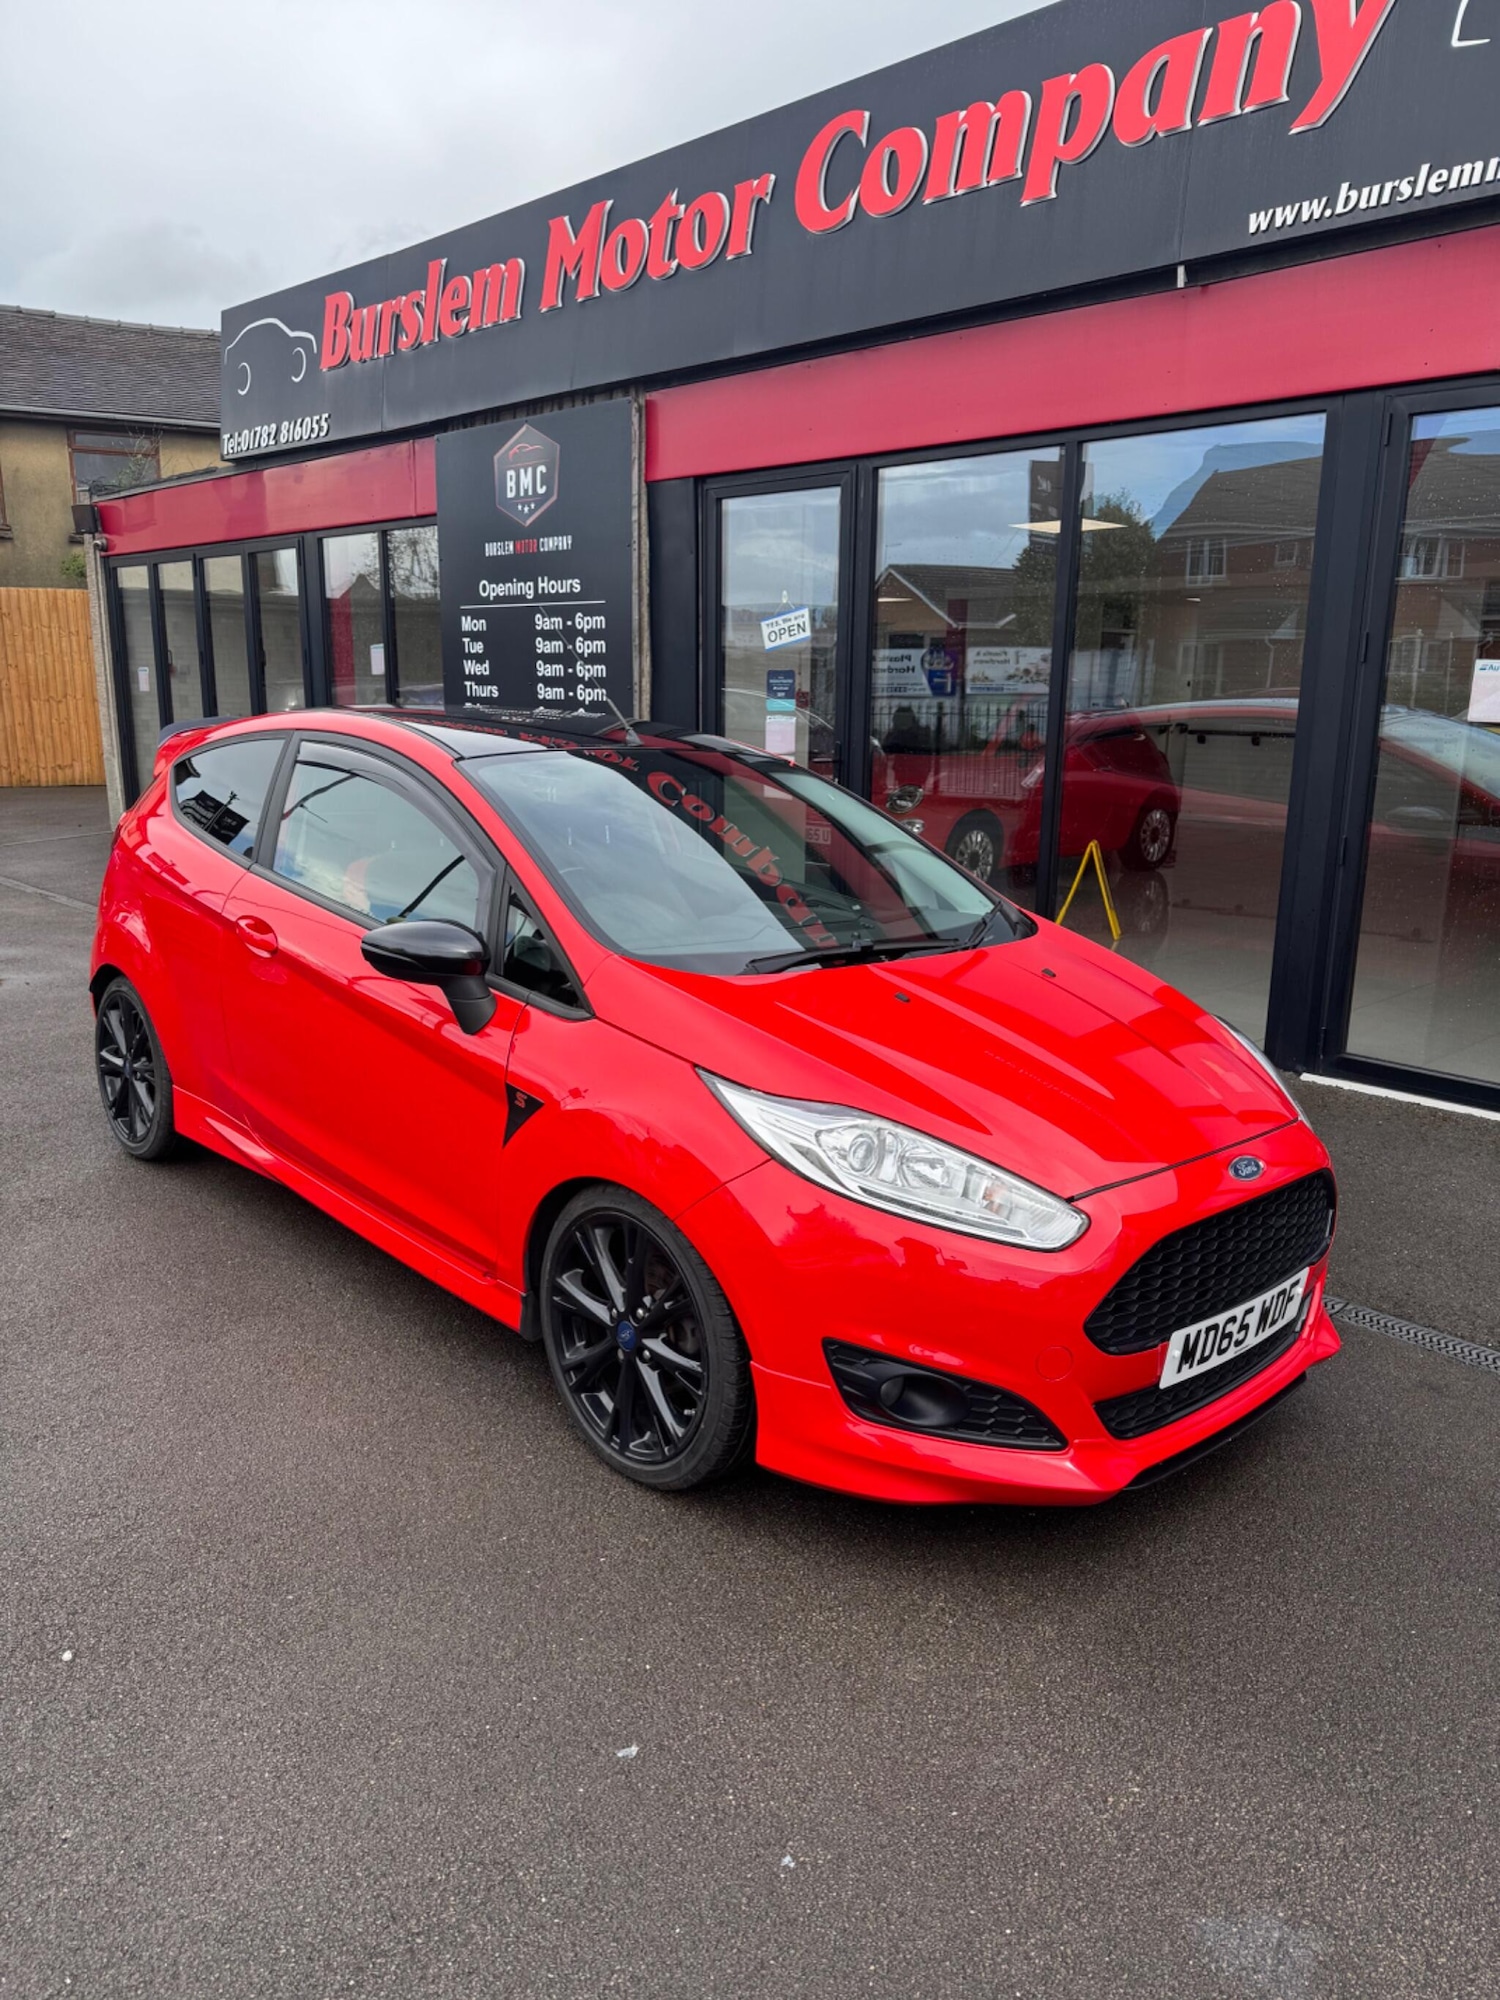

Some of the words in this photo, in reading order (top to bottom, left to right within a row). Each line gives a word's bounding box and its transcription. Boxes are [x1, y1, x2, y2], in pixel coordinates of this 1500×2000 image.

[319, 257, 525, 371] Burslem
[539, 173, 776, 313] Motor
[795, 0, 1400, 235] Company
[222, 423, 277, 455] Tel:01782
[280, 413, 329, 444] 816055
[506, 465, 547, 498] BMC
[479, 577, 534, 601] Opening
[538, 576, 581, 594] Hours
[461, 616, 487, 632] Mon
[535, 613, 563, 630] 9am
[575, 612, 605, 634] 6pm
[768, 620, 806, 643] OPEN
[462, 637, 484, 654] Tue
[535, 637, 564, 654] 9am
[575, 636, 606, 658] 6pm
[463, 660, 490, 676] Wed
[536, 660, 564, 677] 9am
[576, 661, 607, 682] 6pm
[464, 681, 499, 698] Thurs
[537, 683, 565, 700] 9am
[577, 684, 608, 705] 6pm
[1176, 1305, 1256, 1374] MD65
[1254, 1278, 1301, 1338] WDF
